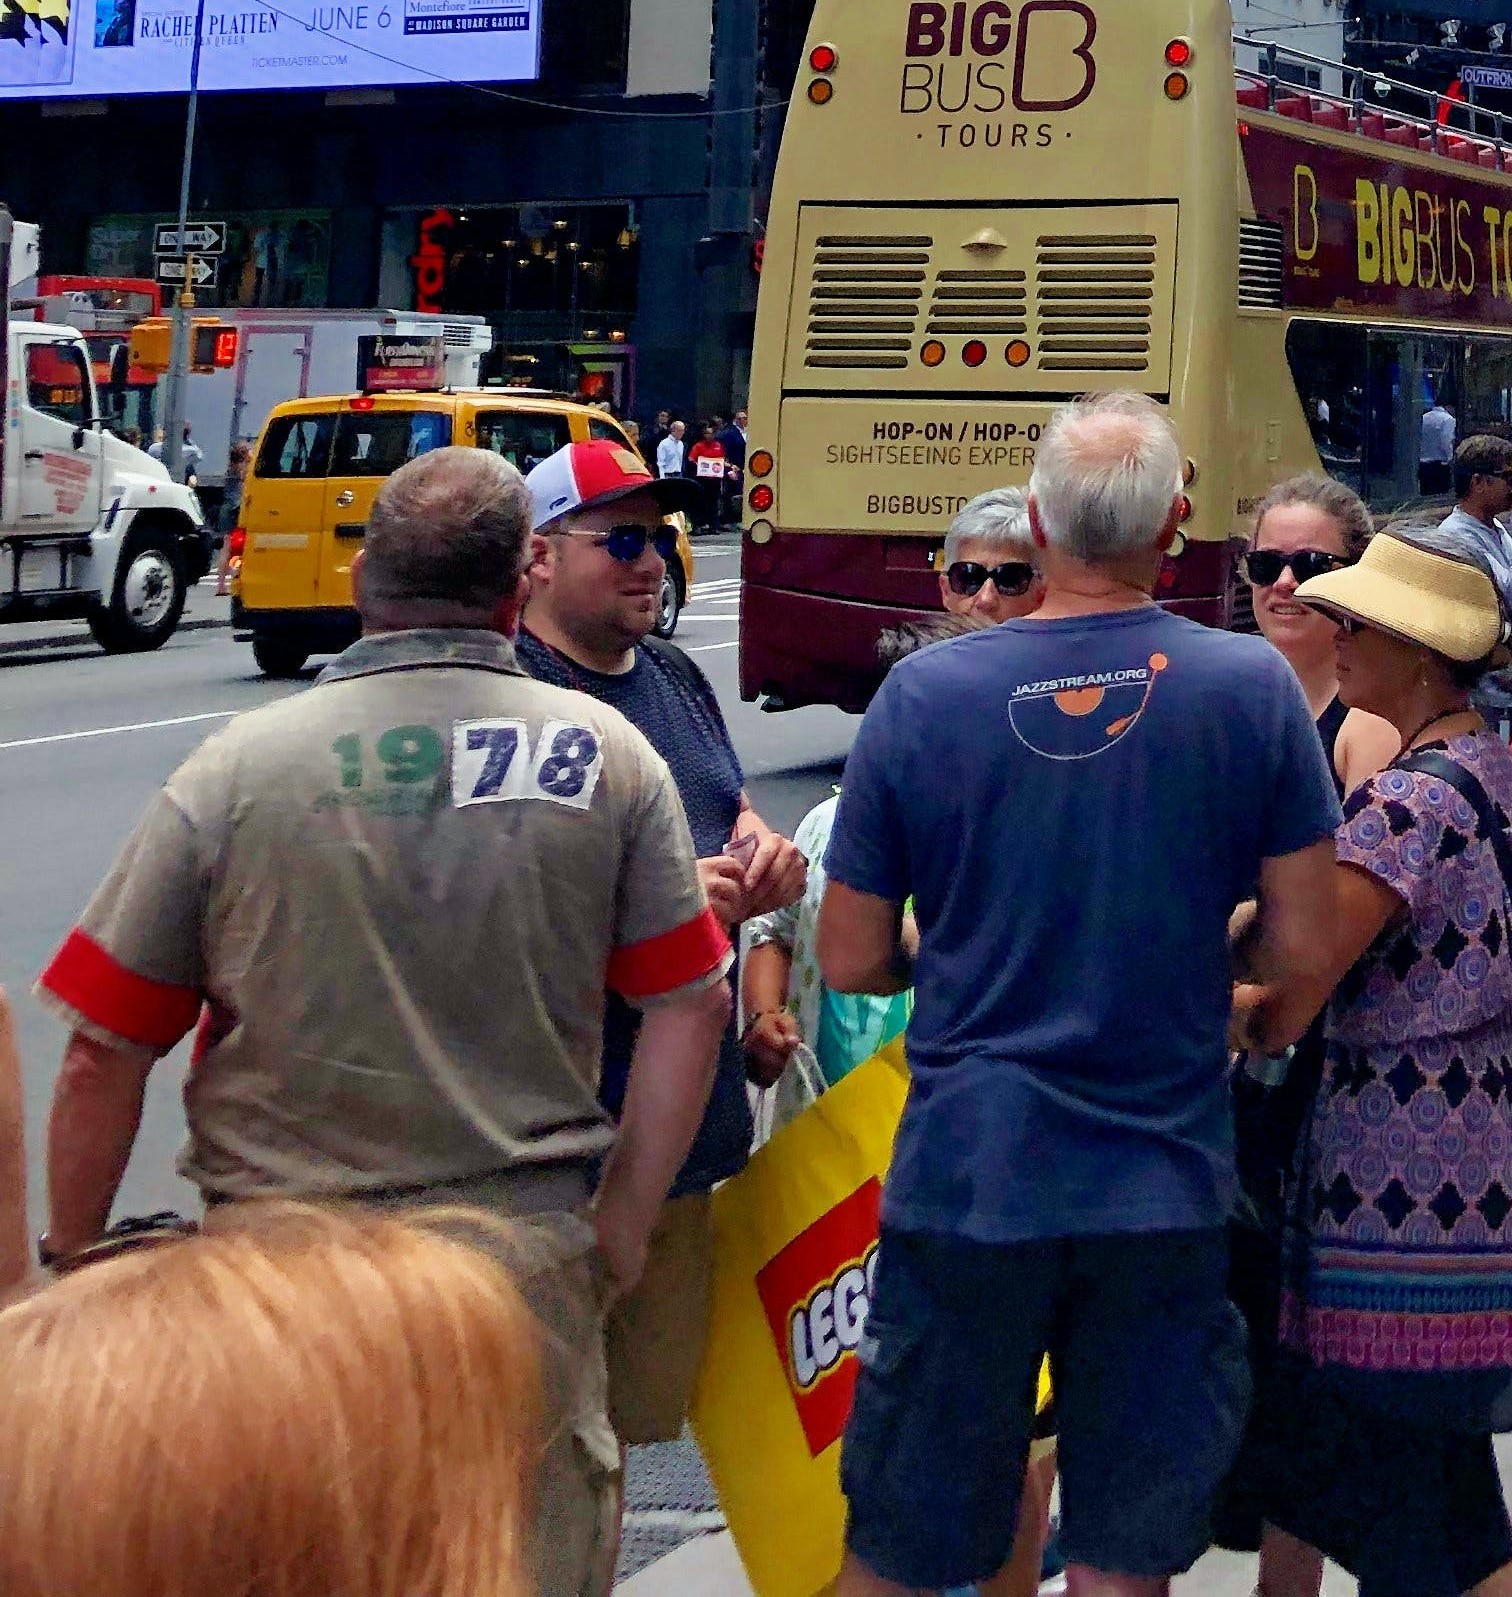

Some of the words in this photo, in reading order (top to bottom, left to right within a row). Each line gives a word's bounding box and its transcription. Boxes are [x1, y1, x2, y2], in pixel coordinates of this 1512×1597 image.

[305, 6, 368, 32] JUNE
[377, 4, 392, 29] 6
[409, 2, 466, 13] Montefiore
[140, 14, 197, 38] RACHE
[209, 12, 278, 36] PLATTEN
[415, 19, 453, 31] MADISON
[456, 17, 489, 30] SQUARE
[491, 16, 526, 28] GARDEN
[905, 2, 1013, 57] BIG
[251, 55, 348, 69] TICKETMASTER.COM
[900, 62, 1007, 113] BUS
[937, 124, 1054, 147] TOURS
[873, 421, 953, 442] HOP-ON
[973, 422, 1046, 442] HOP-O
[826, 444, 962, 466] SIGHTSEEING
[968, 446, 1035, 467] EXPER
[866, 494, 967, 515] BIGBUSTO
[1012, 668, 1147, 696] JAZZSTREAM.ORG
